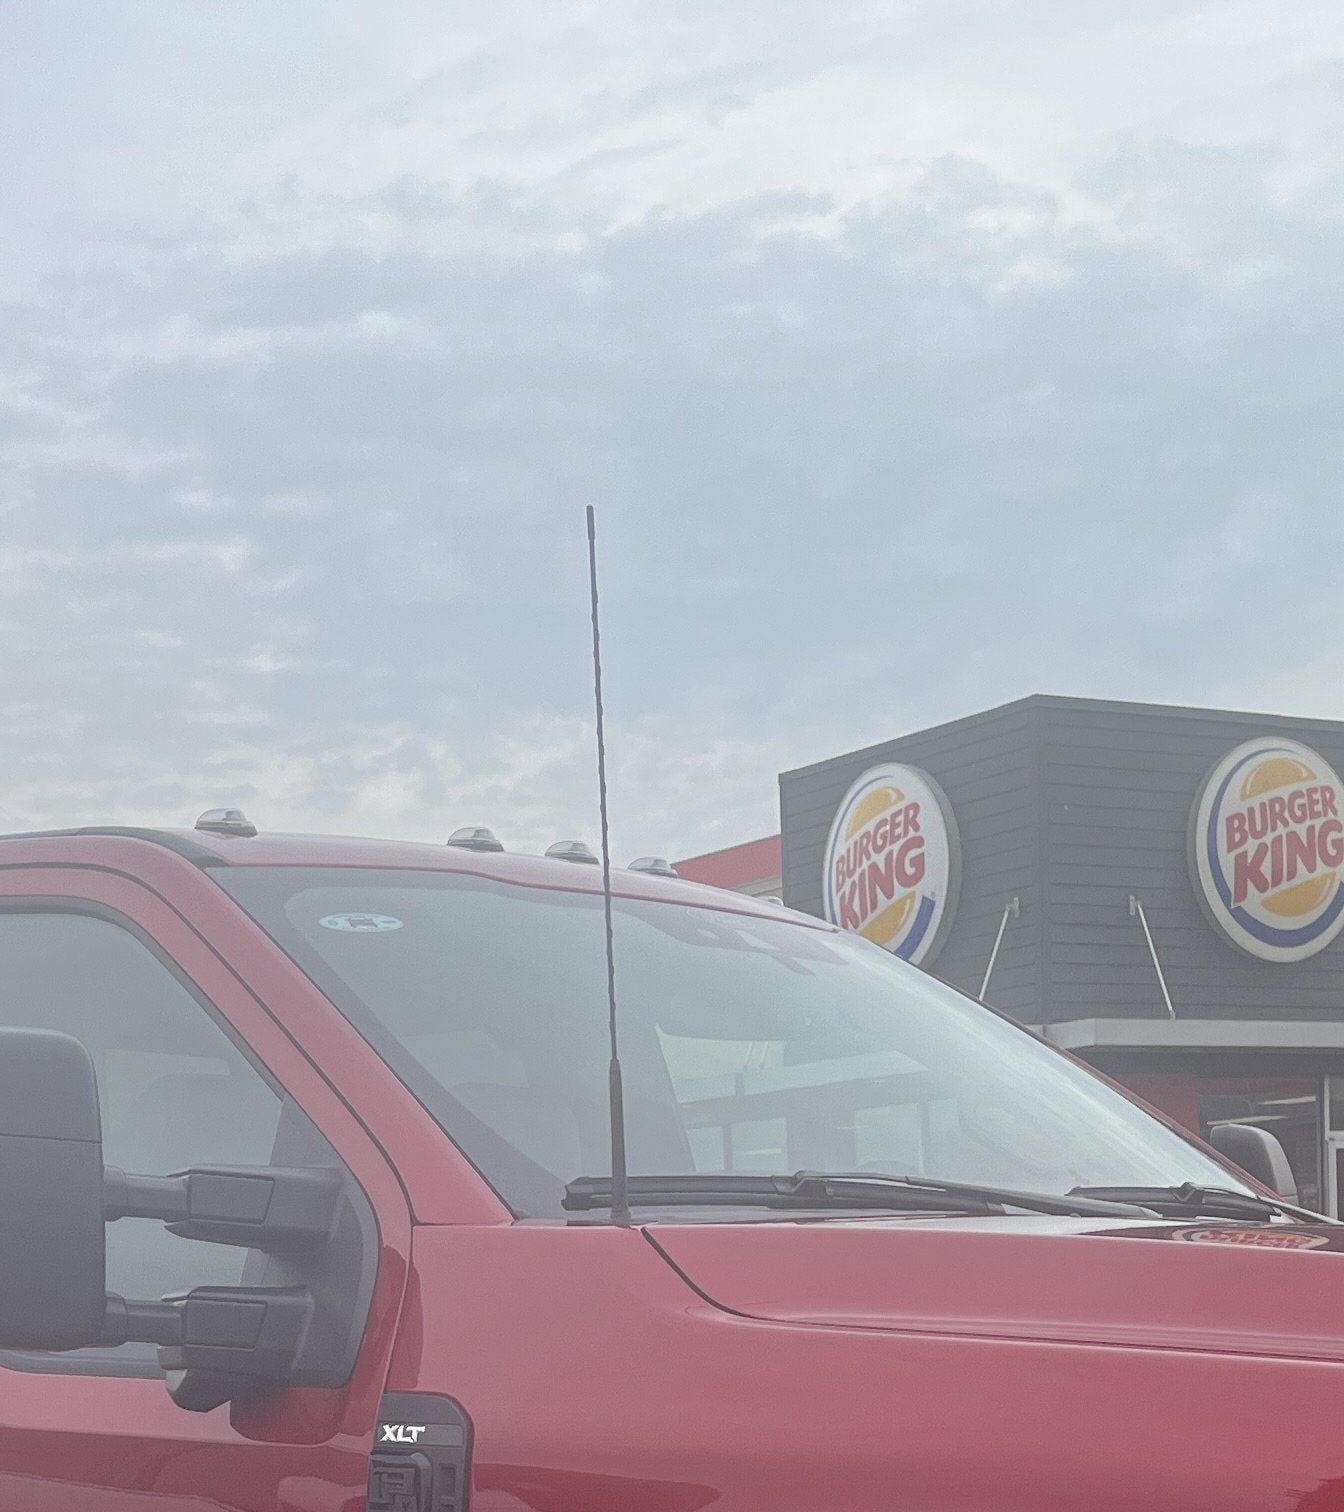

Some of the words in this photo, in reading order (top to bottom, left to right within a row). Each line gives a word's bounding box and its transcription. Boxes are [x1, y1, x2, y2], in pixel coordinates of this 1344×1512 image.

[836, 802, 920, 895] BURGER
[1226, 785, 1338, 854] BURGER
[1232, 819, 1344, 905] KING
[839, 835, 925, 931] KING
[380, 1424, 426, 1443] XLT
